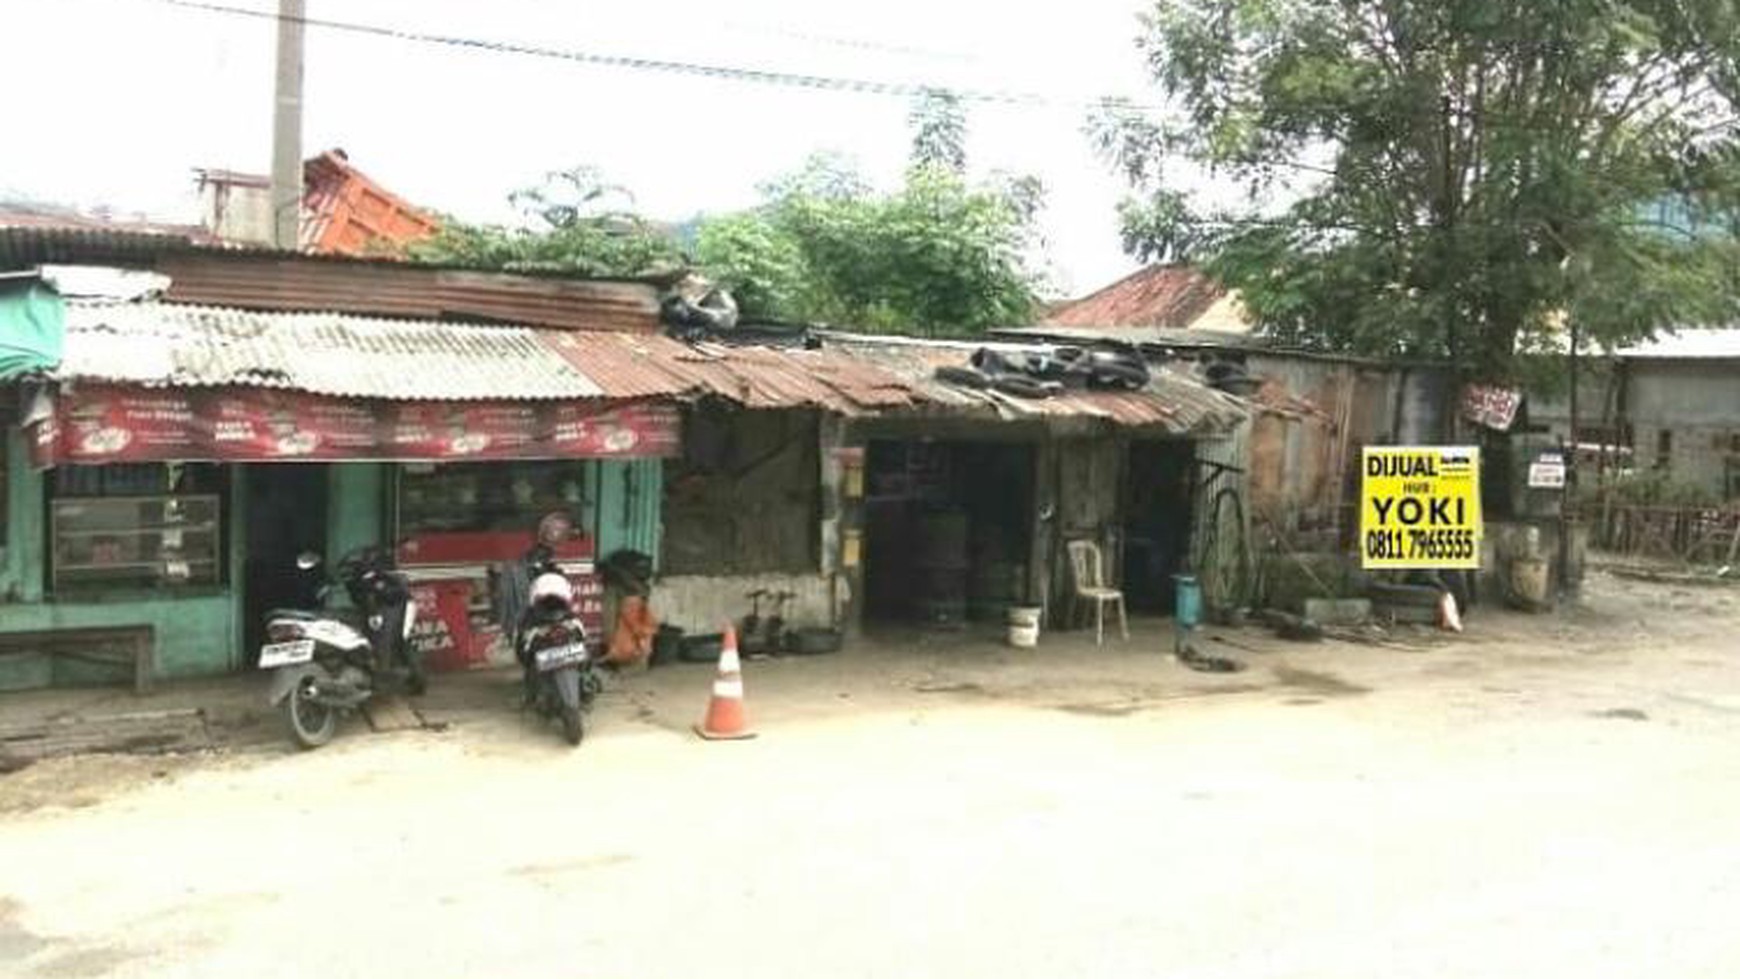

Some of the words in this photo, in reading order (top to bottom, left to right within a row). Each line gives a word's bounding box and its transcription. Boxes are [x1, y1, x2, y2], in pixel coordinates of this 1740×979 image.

[1367, 455, 1438, 477] DIJUAL
[1372, 497, 1464, 525] YOKI
[1367, 529, 1403, 559] 0811
[1408, 529, 1473, 559] 7965555
